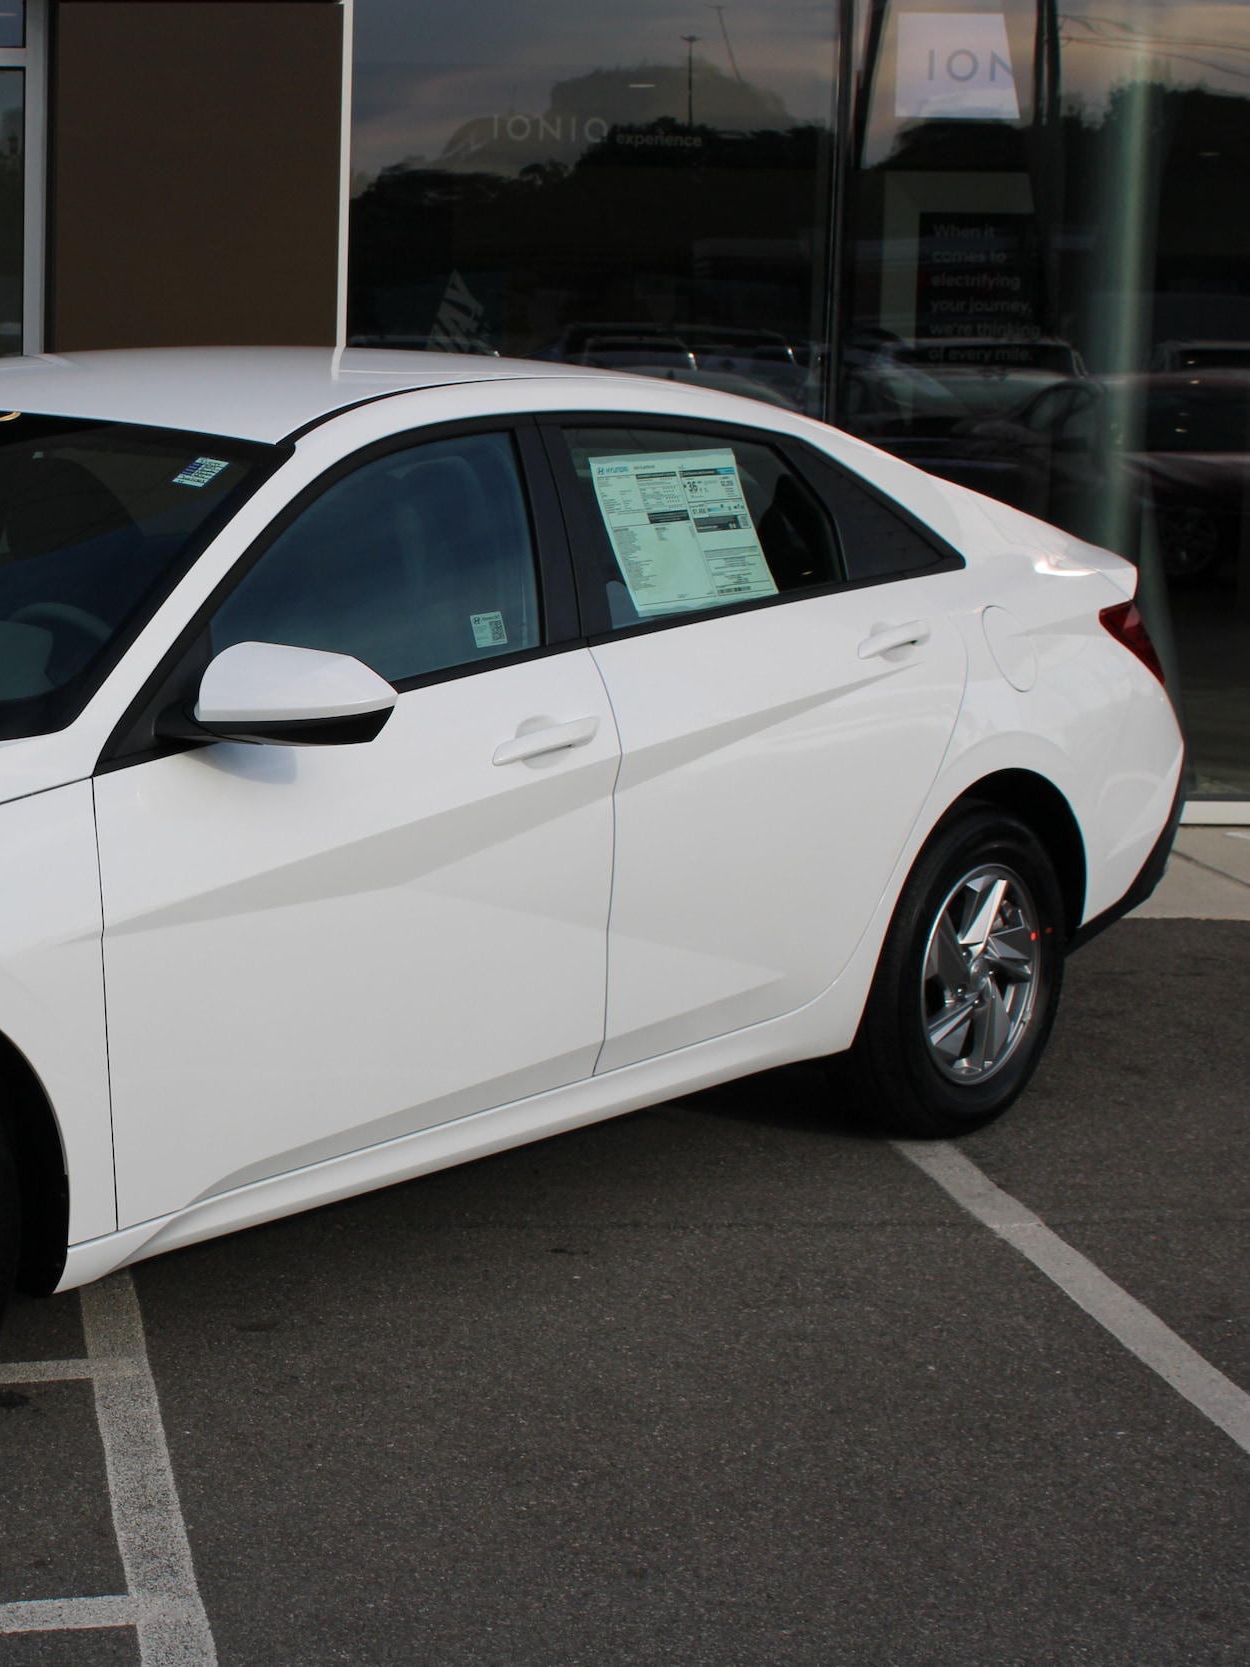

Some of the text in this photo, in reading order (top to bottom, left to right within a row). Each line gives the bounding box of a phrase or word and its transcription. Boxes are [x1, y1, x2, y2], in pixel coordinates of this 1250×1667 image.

[493, 115, 703, 148] IONIQ experience
[933, 224, 996, 238] When it
[932, 250, 1007, 263] comes to
[931, 272, 1021, 290] electrifying
[930, 300, 966, 314] your
[977, 321, 1041, 340] thinking
[948, 348, 992, 363] every
[687, 481, 698, 492] 36
